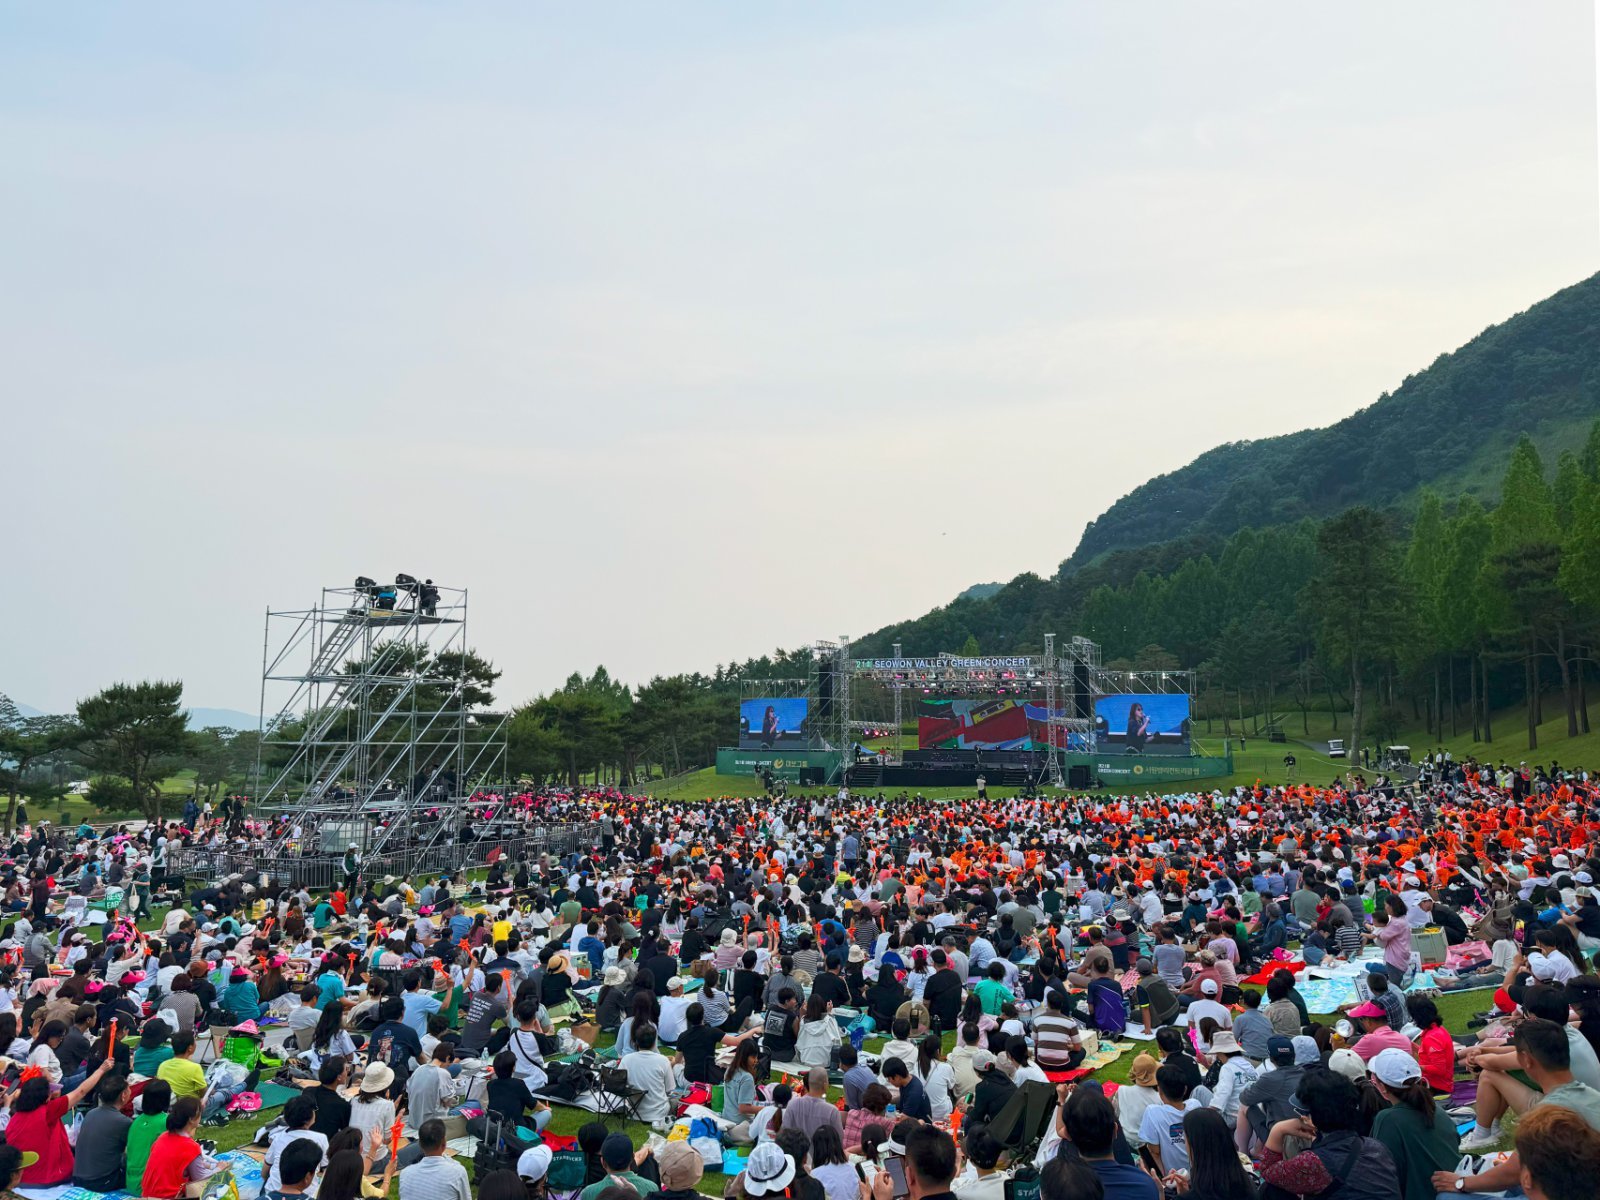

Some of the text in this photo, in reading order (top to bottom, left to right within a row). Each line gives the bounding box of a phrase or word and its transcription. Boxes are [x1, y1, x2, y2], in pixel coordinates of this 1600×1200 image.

[875, 660, 912, 668] SEOWON
[915, 659, 947, 668] VALLEY
[950, 659, 982, 667] GREEN
[984, 658, 1031, 667] CONCERT
